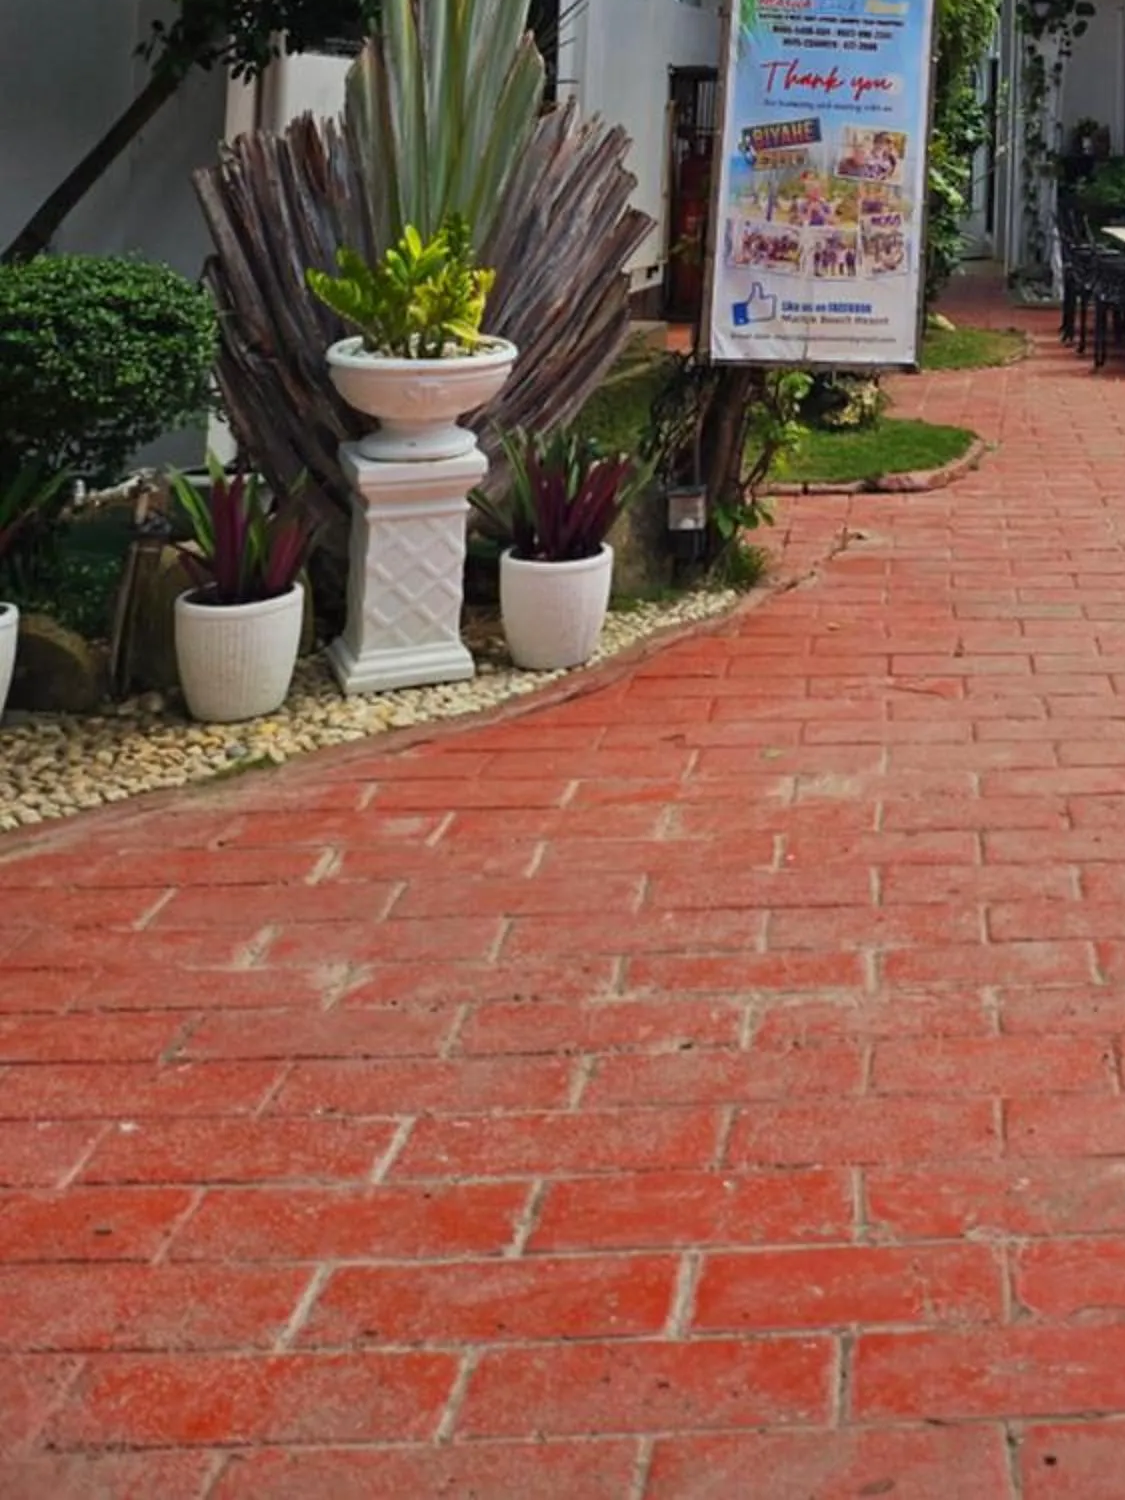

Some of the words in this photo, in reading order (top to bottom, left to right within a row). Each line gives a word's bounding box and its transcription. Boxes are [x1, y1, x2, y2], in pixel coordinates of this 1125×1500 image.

[760, 58, 843, 93] Thank
[850, 76, 893, 101] you
[751, 120, 817, 150] BIYAHE
